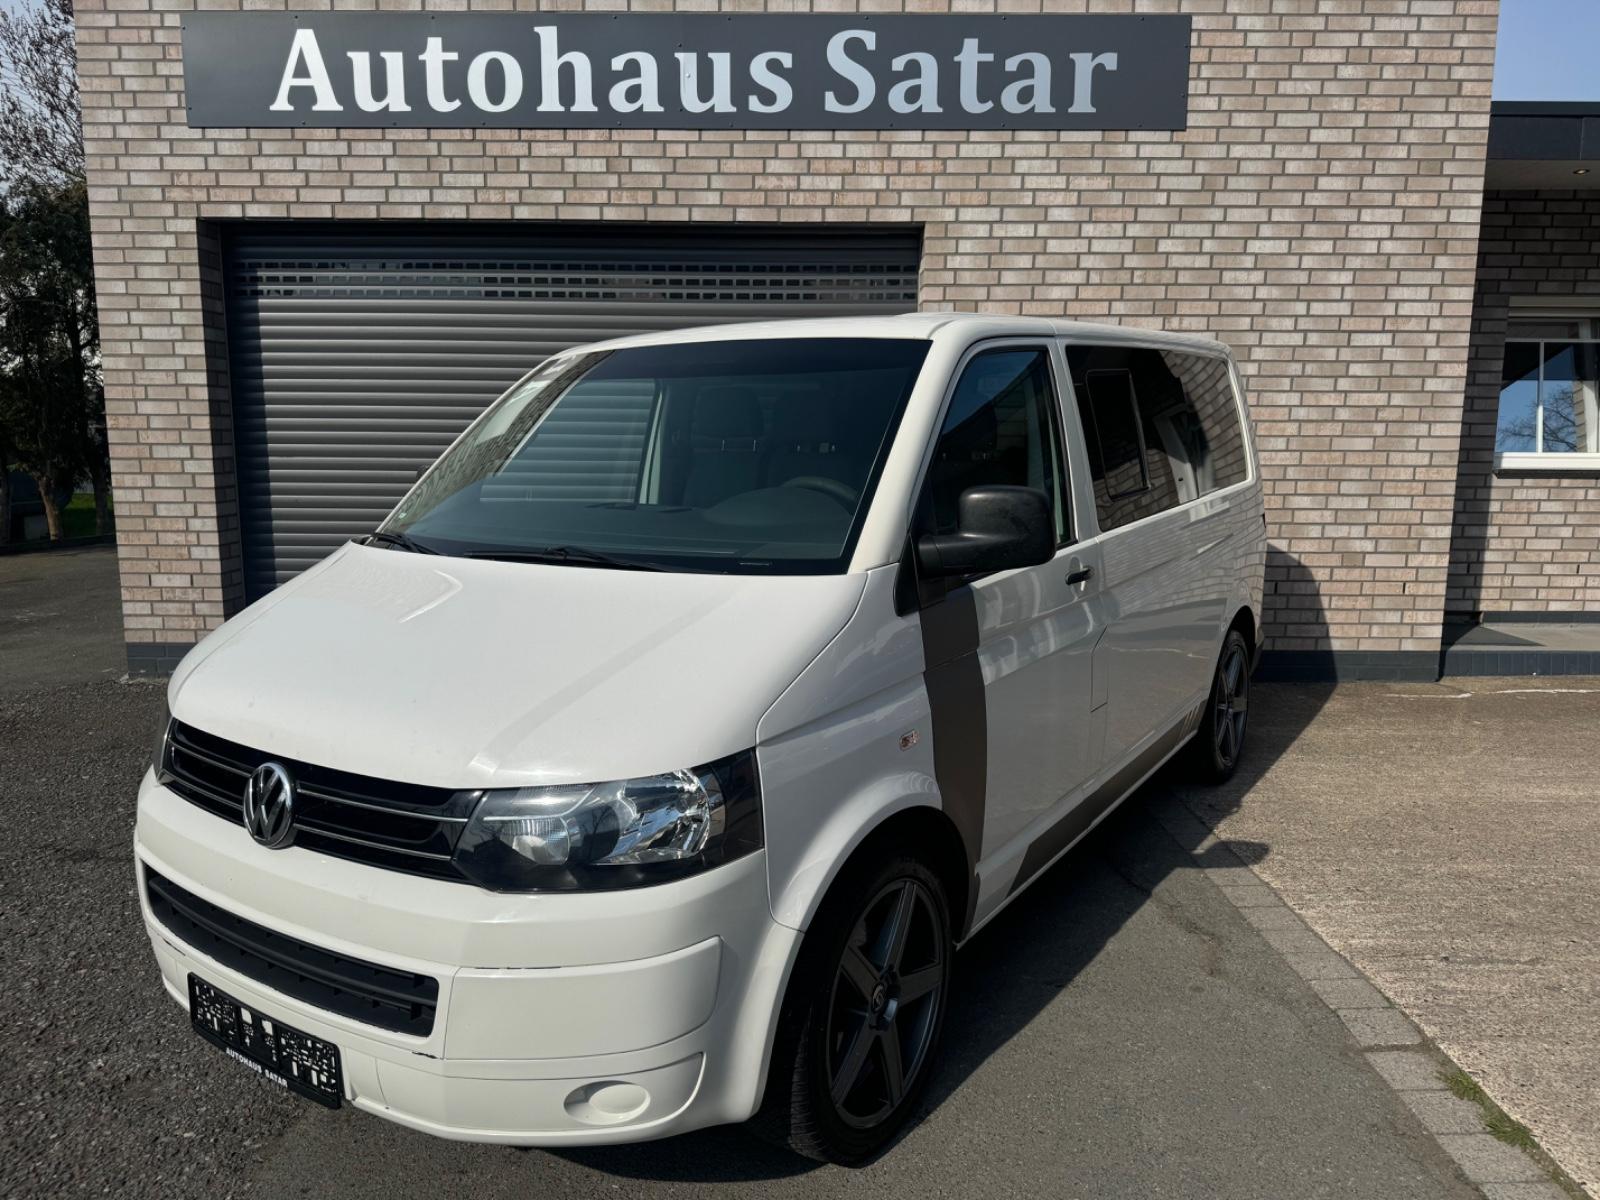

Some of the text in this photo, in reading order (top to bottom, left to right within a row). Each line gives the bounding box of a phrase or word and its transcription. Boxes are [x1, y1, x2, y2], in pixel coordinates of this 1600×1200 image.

[269, 25, 1118, 114] Autohaus Satar
[225, 1047, 262, 1073] AUTOHAUS
